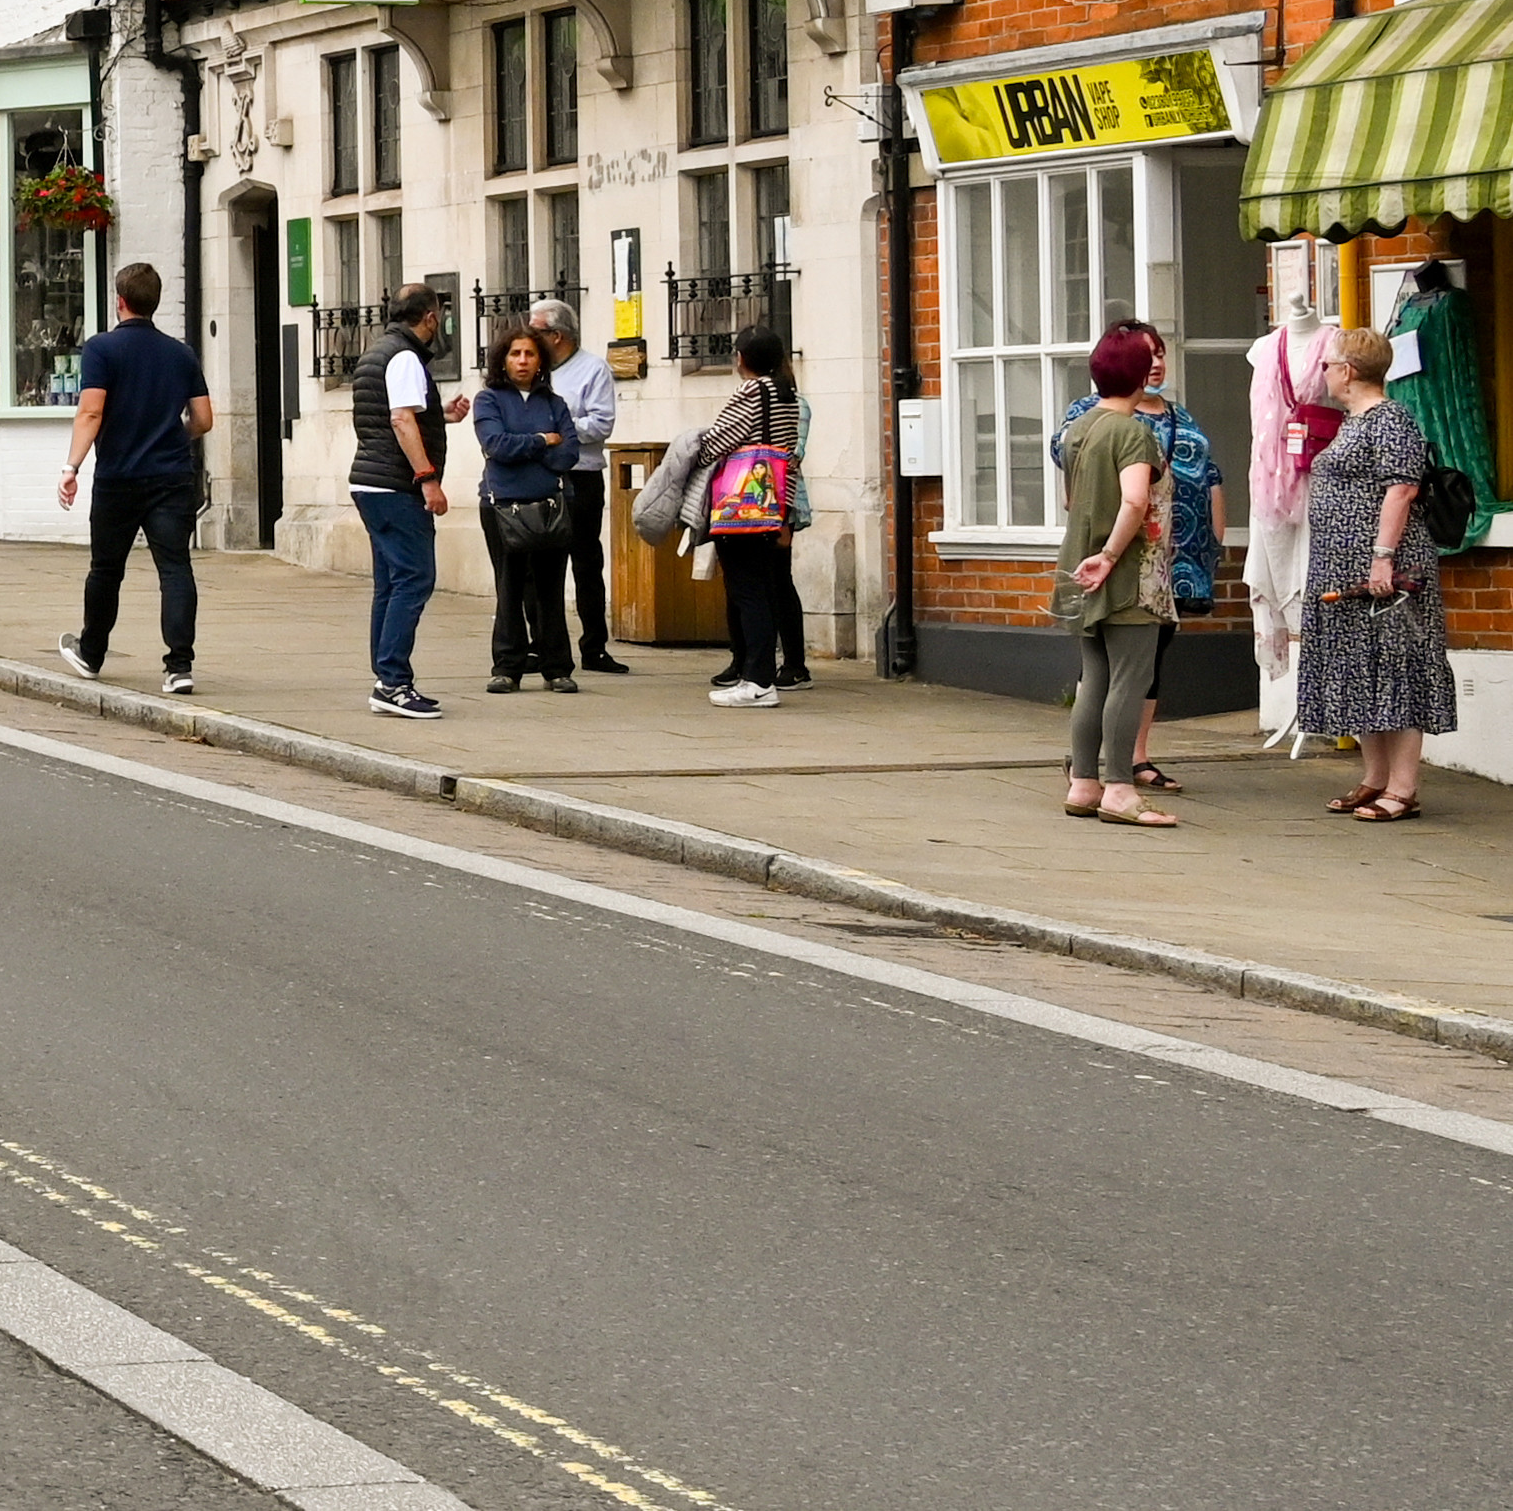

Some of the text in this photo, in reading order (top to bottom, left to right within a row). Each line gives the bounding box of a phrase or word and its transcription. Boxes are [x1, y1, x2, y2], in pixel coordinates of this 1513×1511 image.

[993, 74, 1097, 149] URBAN
[1086, 80, 1116, 104] VAPE
[1094, 105, 1121, 130] SHOP
